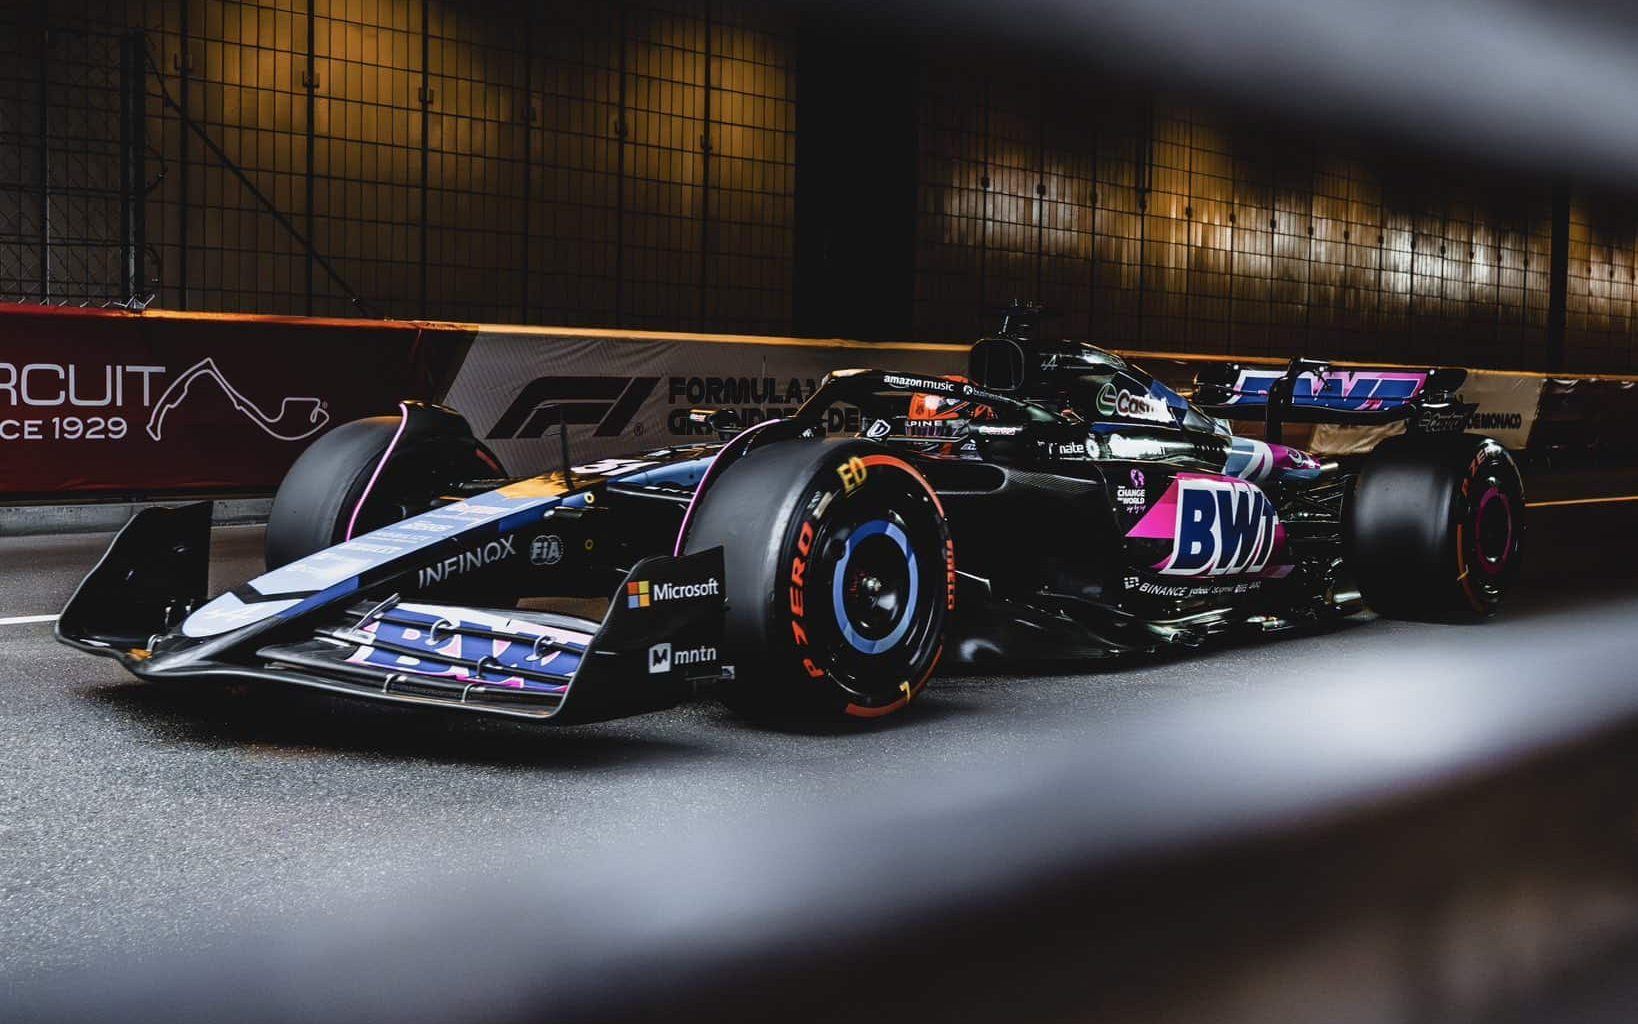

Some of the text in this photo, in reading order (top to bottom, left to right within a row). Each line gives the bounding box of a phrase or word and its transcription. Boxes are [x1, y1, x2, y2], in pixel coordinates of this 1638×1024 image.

[668, 376, 802, 405] FORMULA
[883, 374, 954, 392] amazon music
[1116, 388, 1167, 421] Cast
[52, 416, 128, 439] 1929
[1481, 413, 1522, 430] MONACO
[1059, 442, 1086, 455] nate
[1158, 479, 1278, 575] BWT
[418, 534, 517, 590] INFINOX
[653, 578, 719, 602] Microsoft
[790, 521, 814, 645] ZERO
[1140, 582, 1187, 597] BINANCE
[674, 645, 717, 665] mntn
[803, 658, 825, 677] P
